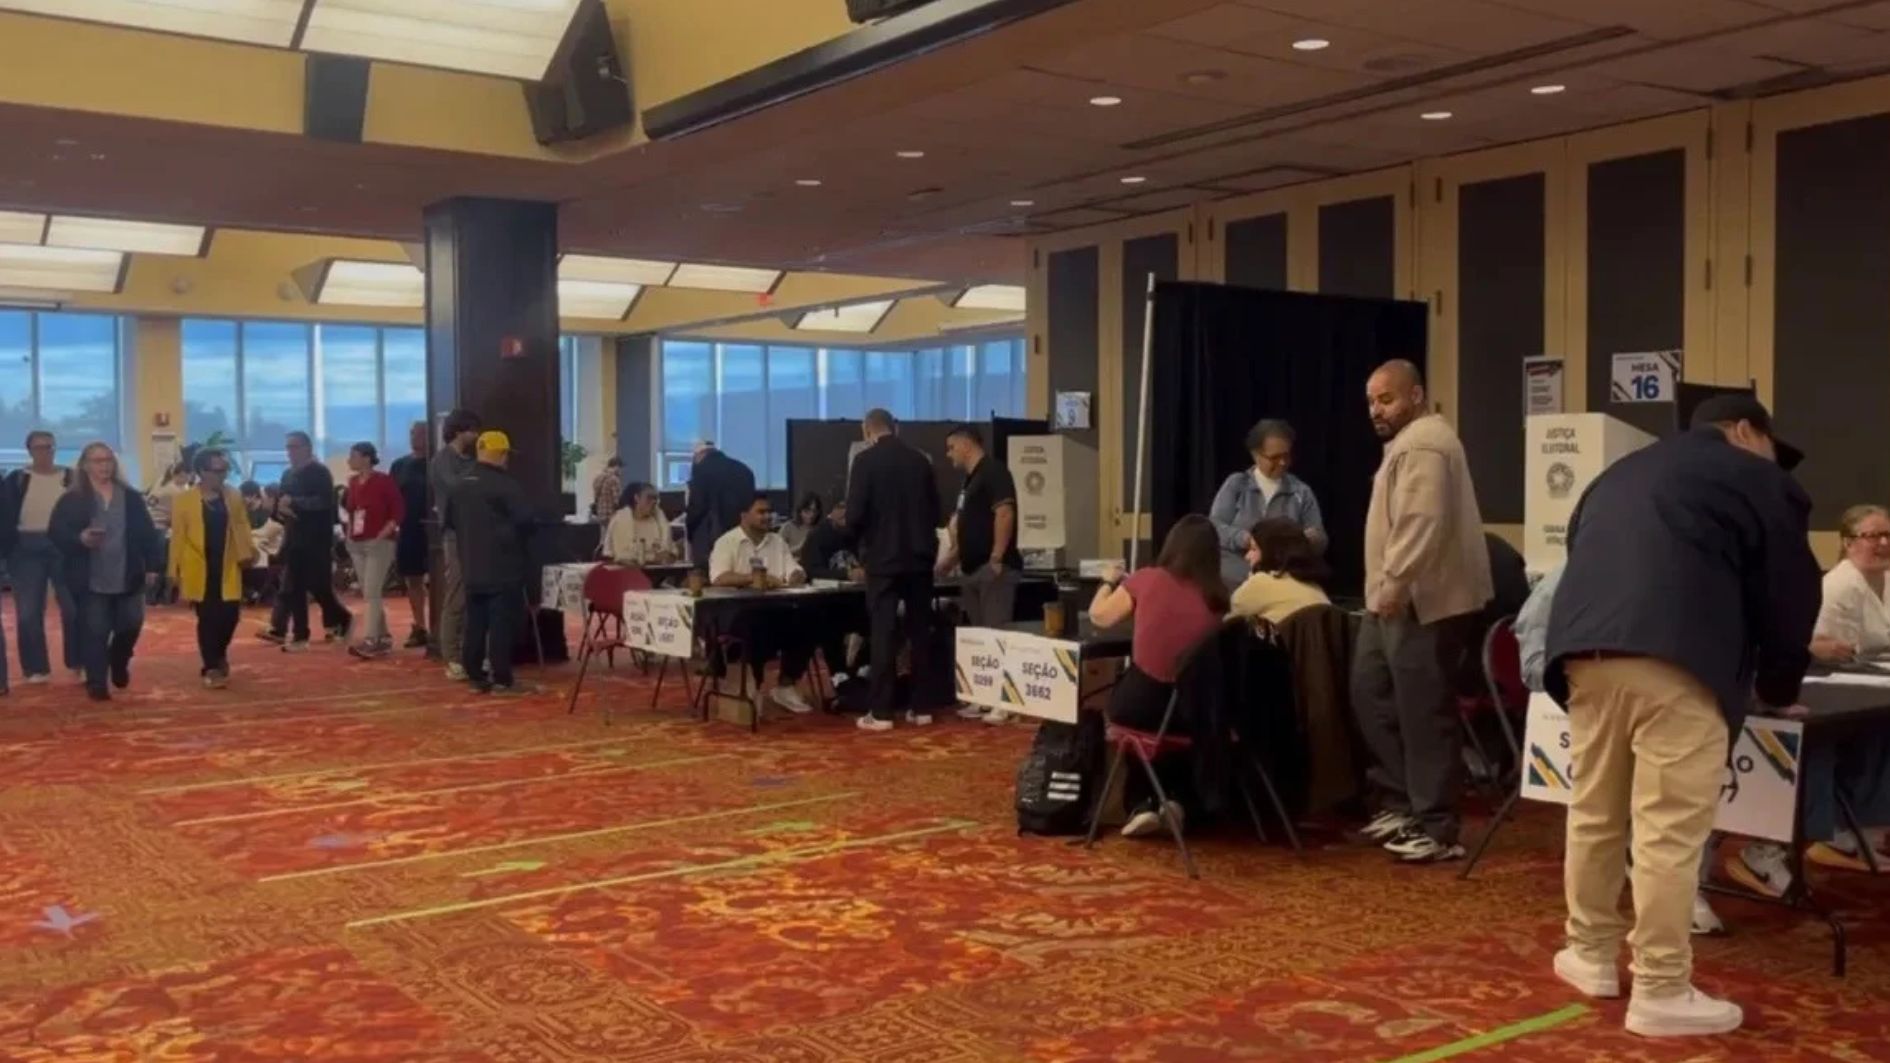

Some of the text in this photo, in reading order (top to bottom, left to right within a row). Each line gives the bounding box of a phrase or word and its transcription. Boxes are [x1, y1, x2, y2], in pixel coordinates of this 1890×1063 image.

[1631, 362, 1659, 372] MESA
[1632, 375, 1660, 399] 16
[1021, 661, 1058, 680] SEÇÃO
